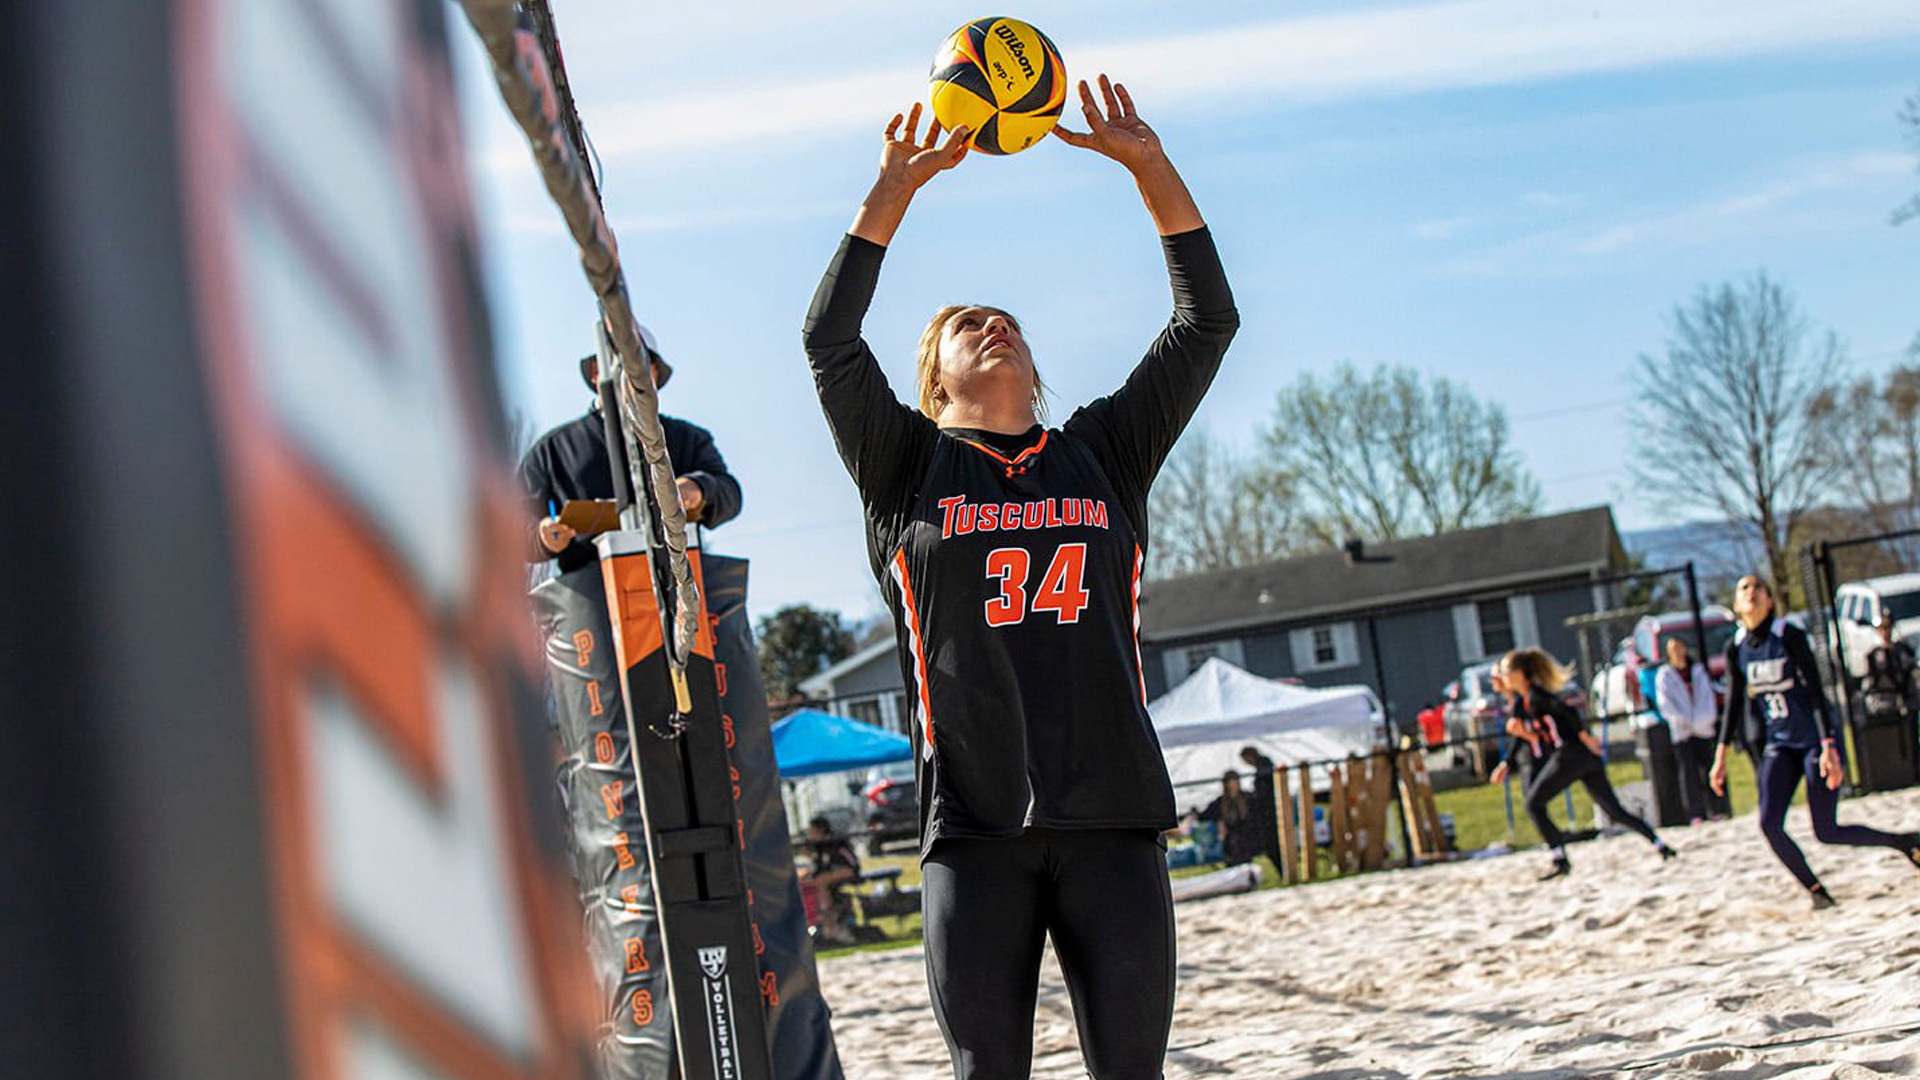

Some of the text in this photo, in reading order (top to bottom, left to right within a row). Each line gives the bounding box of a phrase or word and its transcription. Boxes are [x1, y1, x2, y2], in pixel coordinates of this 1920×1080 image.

[995, 25, 1035, 80] Wilson
[985, 543, 1090, 627] 34
[573, 629, 655, 1025] PIONEERS
